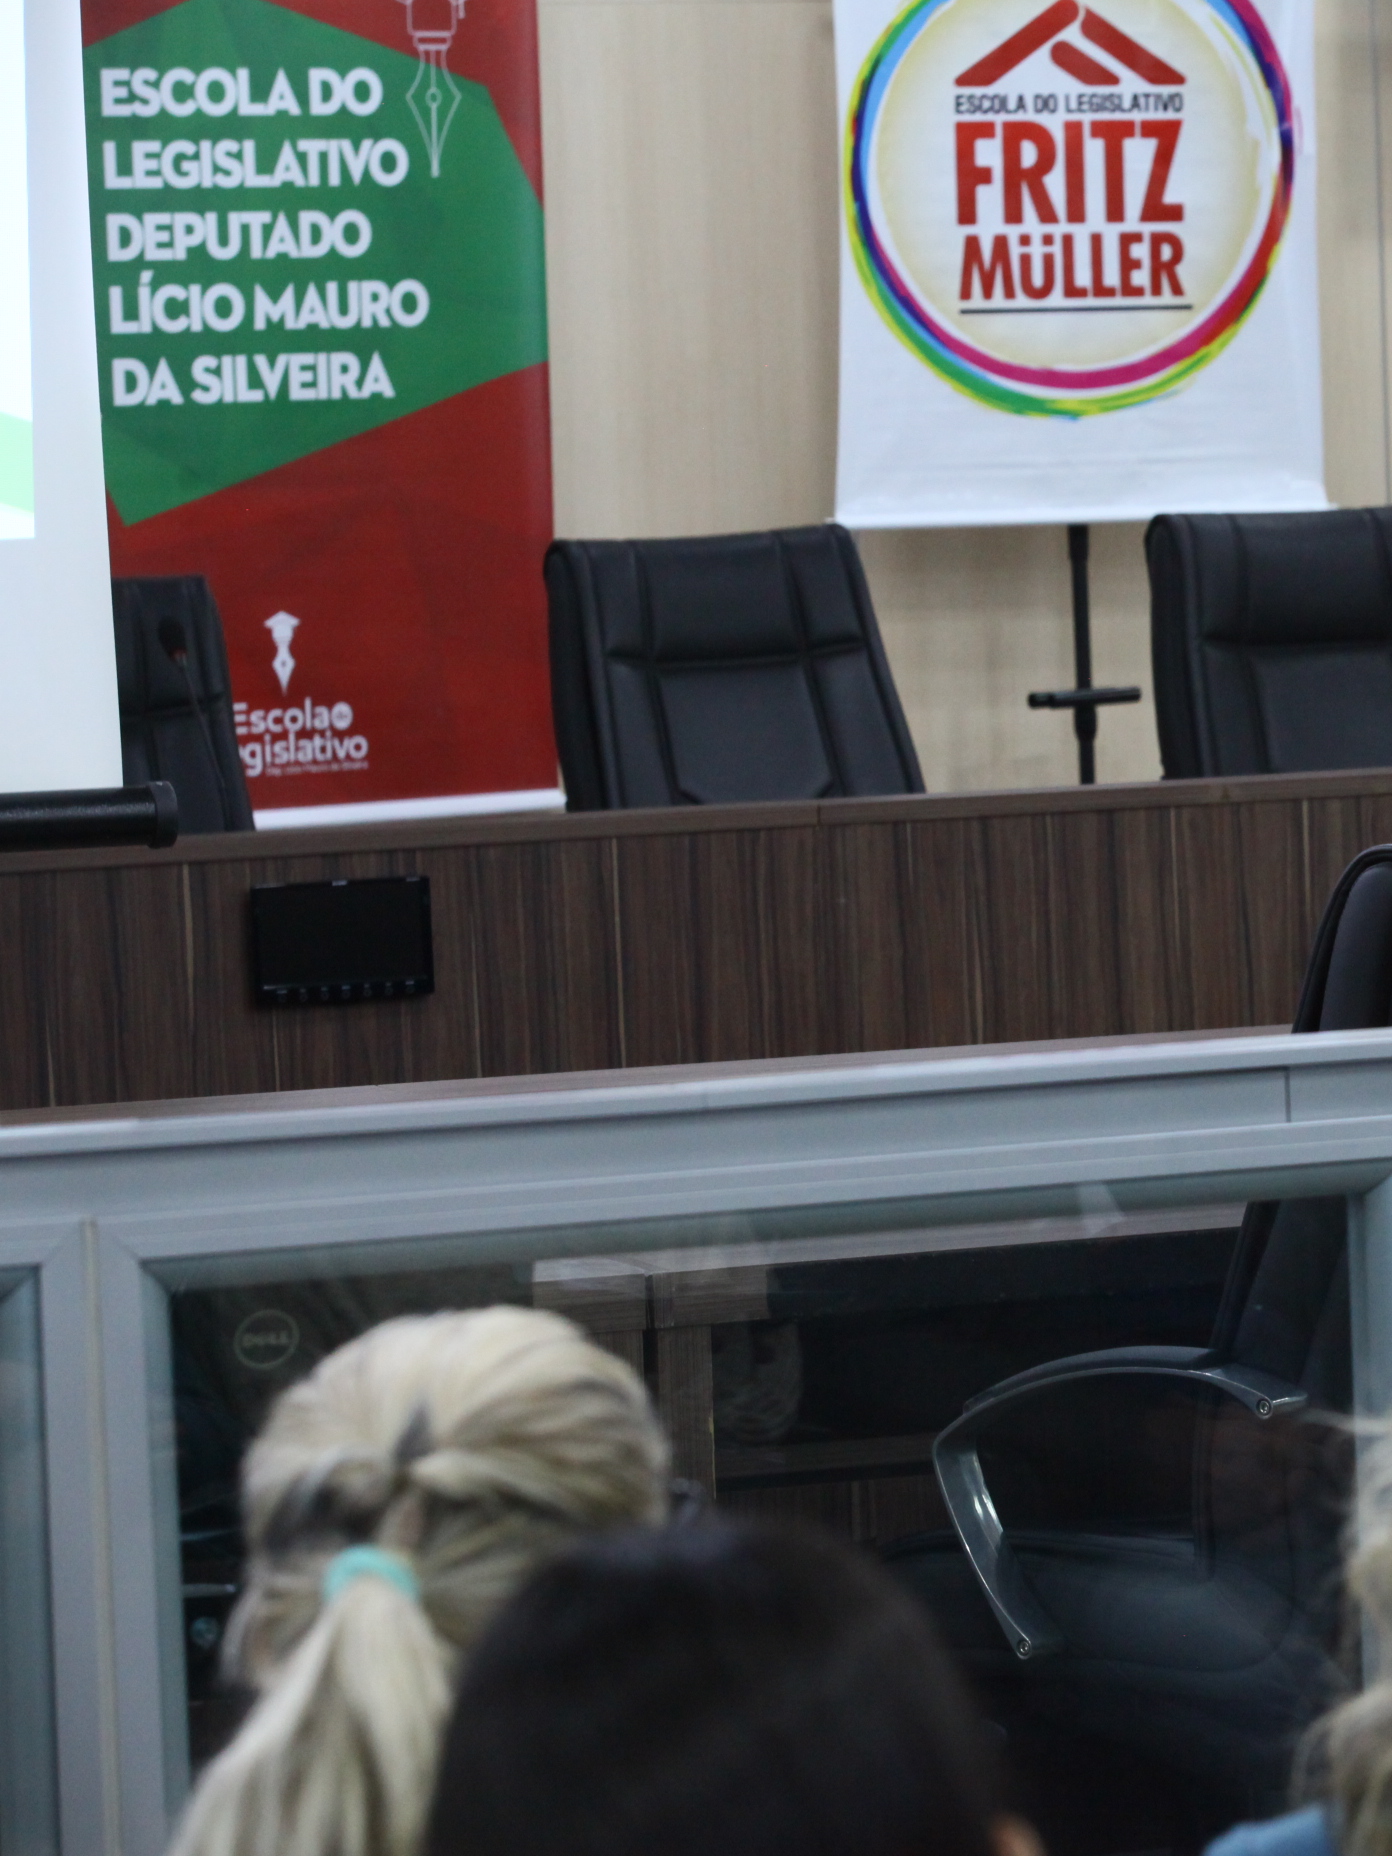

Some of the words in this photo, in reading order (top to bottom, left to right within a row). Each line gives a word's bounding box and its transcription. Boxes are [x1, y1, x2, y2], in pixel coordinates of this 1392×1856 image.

[101, 67, 302, 117] ESCOLA
[308, 66, 383, 116] DO
[955, 94, 1028, 114] ESCOLA
[1034, 94, 1057, 113] DO
[1064, 92, 1183, 113] LEGISLATIVO
[102, 138, 409, 189] LEGISLATIVO
[955, 119, 1184, 225] FRITZ
[106, 209, 373, 262] DEPUTADO
[960, 232, 1184, 301] MÜLLER
[109, 269, 246, 334] LÍCIO
[253, 279, 430, 331] MAURO
[111, 357, 184, 406] DA
[190, 351, 396, 404] SILVEIRA
[233, 697, 331, 735] Escola
[238, 729, 369, 777] gislativo
